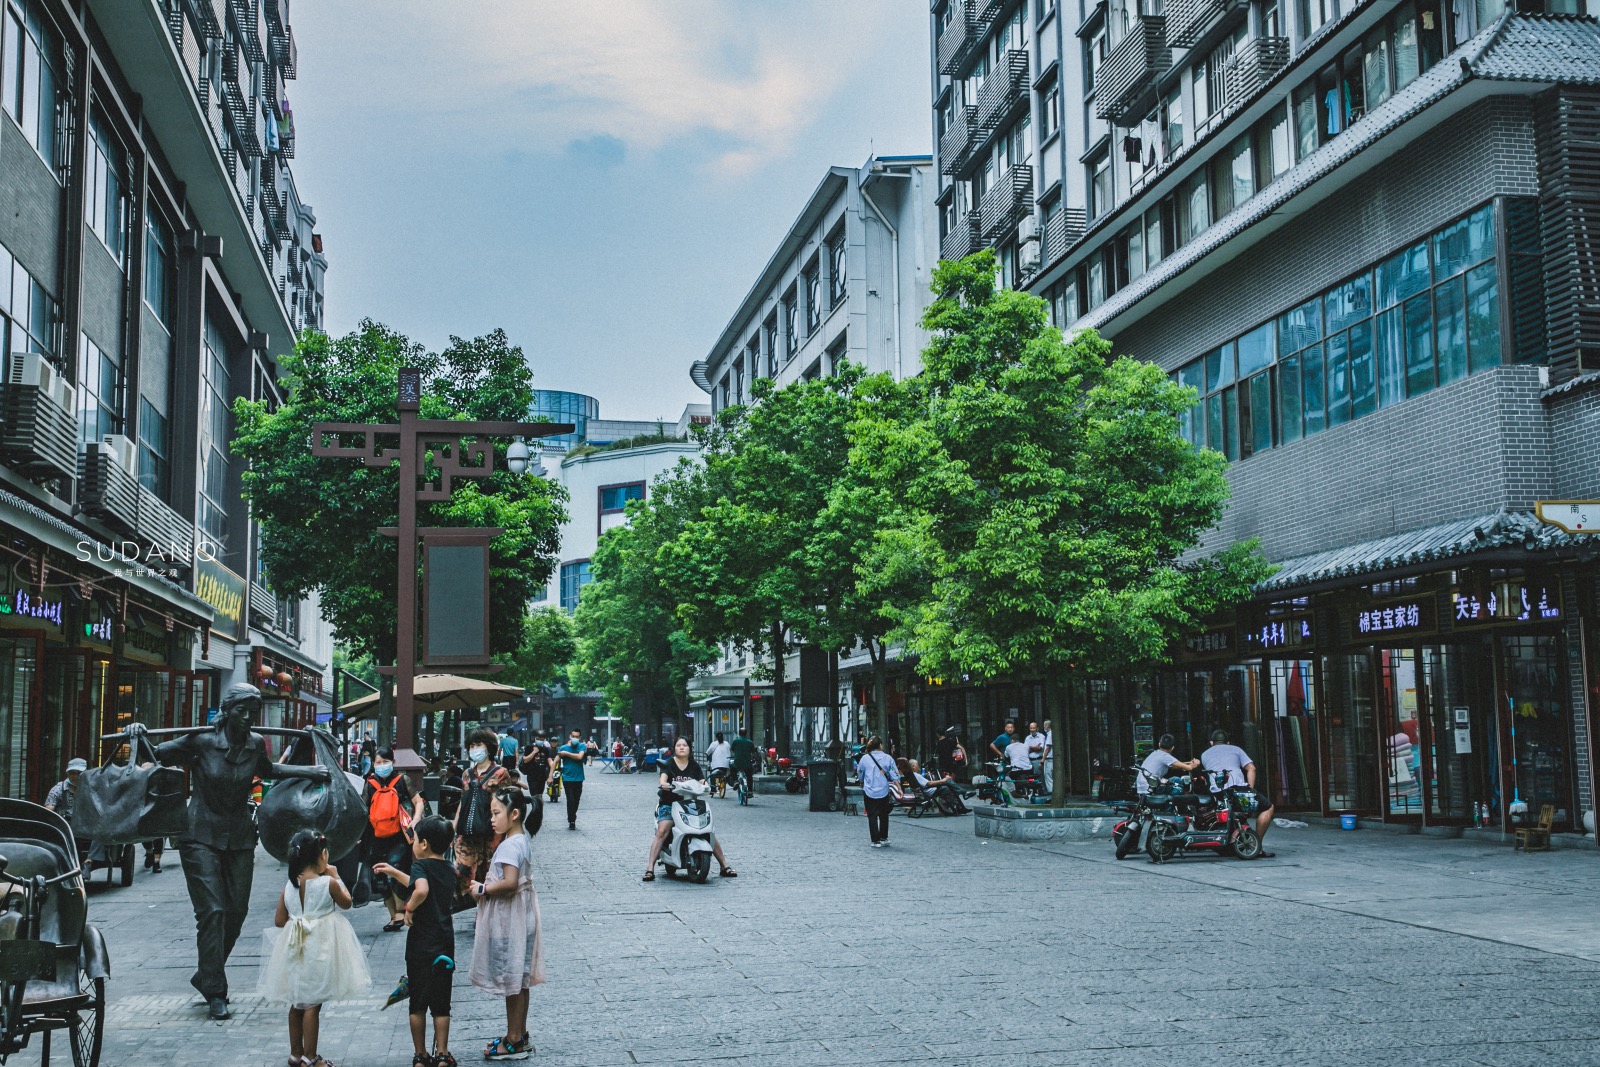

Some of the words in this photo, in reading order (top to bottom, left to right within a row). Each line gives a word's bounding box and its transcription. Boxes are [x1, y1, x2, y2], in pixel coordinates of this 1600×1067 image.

[1570, 503, 1580, 514] 南
[1581, 514, 1588, 523] S
[1359, 604, 1419, 633] 棉宝宝家纺
